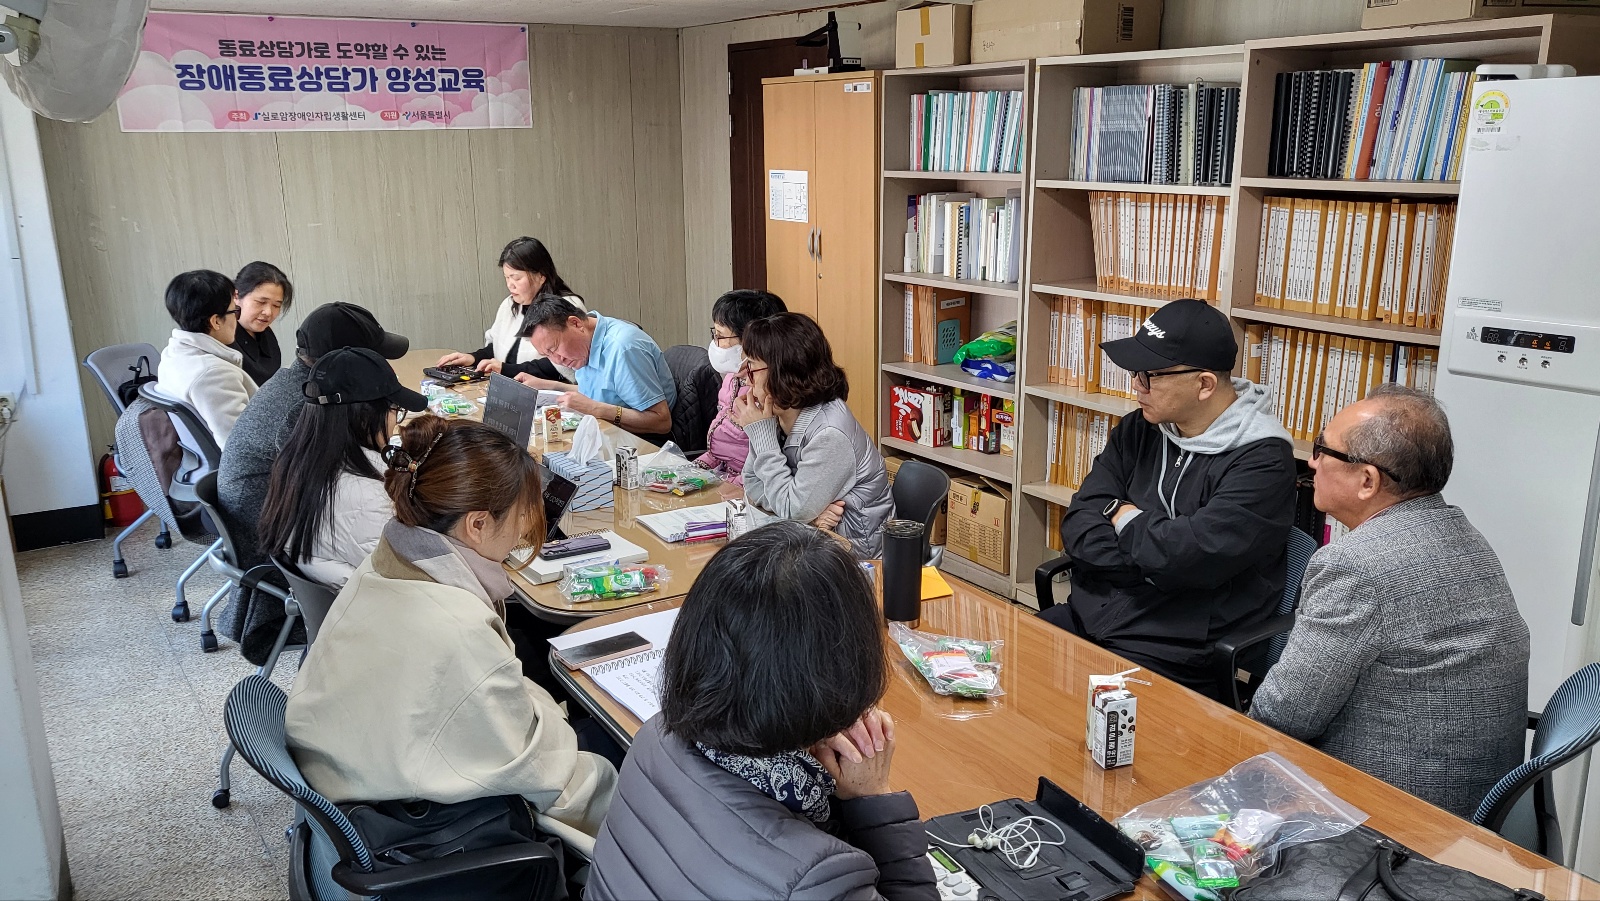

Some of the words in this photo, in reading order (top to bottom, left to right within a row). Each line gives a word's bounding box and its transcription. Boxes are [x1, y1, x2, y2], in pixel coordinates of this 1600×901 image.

[218, 39, 331, 59] 동료상담가로
[336, 42, 388, 60] 도약할
[393, 43, 410, 61] 수
[414, 44, 446, 61] 있는
[174, 63, 379, 93] 장애동료상담가
[386, 67, 485, 93] 양성교육
[231, 112, 247, 121] 주최
[261, 111, 366, 122] 실로암장애인자립생활센터
[383, 111, 397, 120] 지원
[411, 110, 451, 120] 서울특별시
